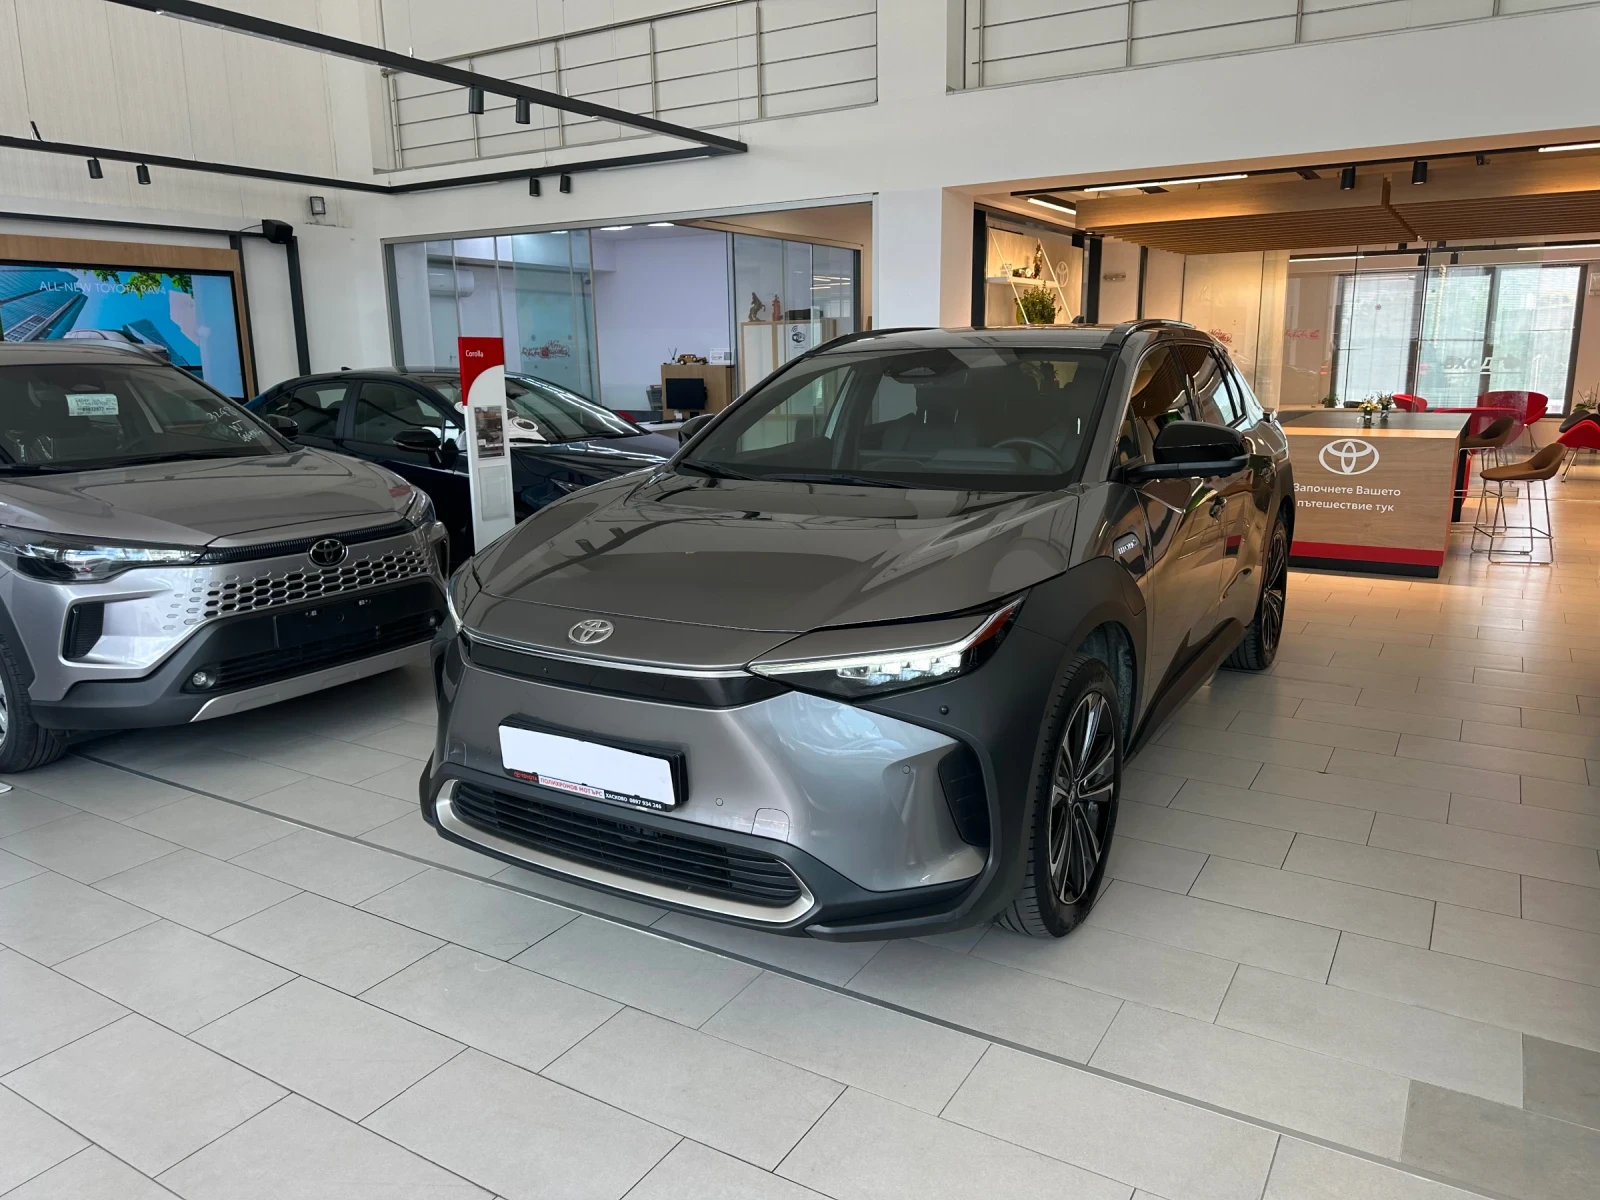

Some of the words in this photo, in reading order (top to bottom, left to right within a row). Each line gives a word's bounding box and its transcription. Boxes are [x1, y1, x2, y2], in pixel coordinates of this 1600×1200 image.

[40, 281, 92, 293] ALL-NEW
[95, 283, 137, 294] TOYOTA
[465, 349, 484, 358] Corolla
[1293, 483, 1354, 495] Започнете
[1356, 485, 1401, 497] Вашето
[1297, 499, 1373, 511] пътешествие
[1376, 503, 1395, 514] тук
[540, 778, 578, 791] ПОЛИХРОНОВ
[578, 787, 603, 797] МОТЪРС
[605, 793, 628, 802] ХАСКОВО
